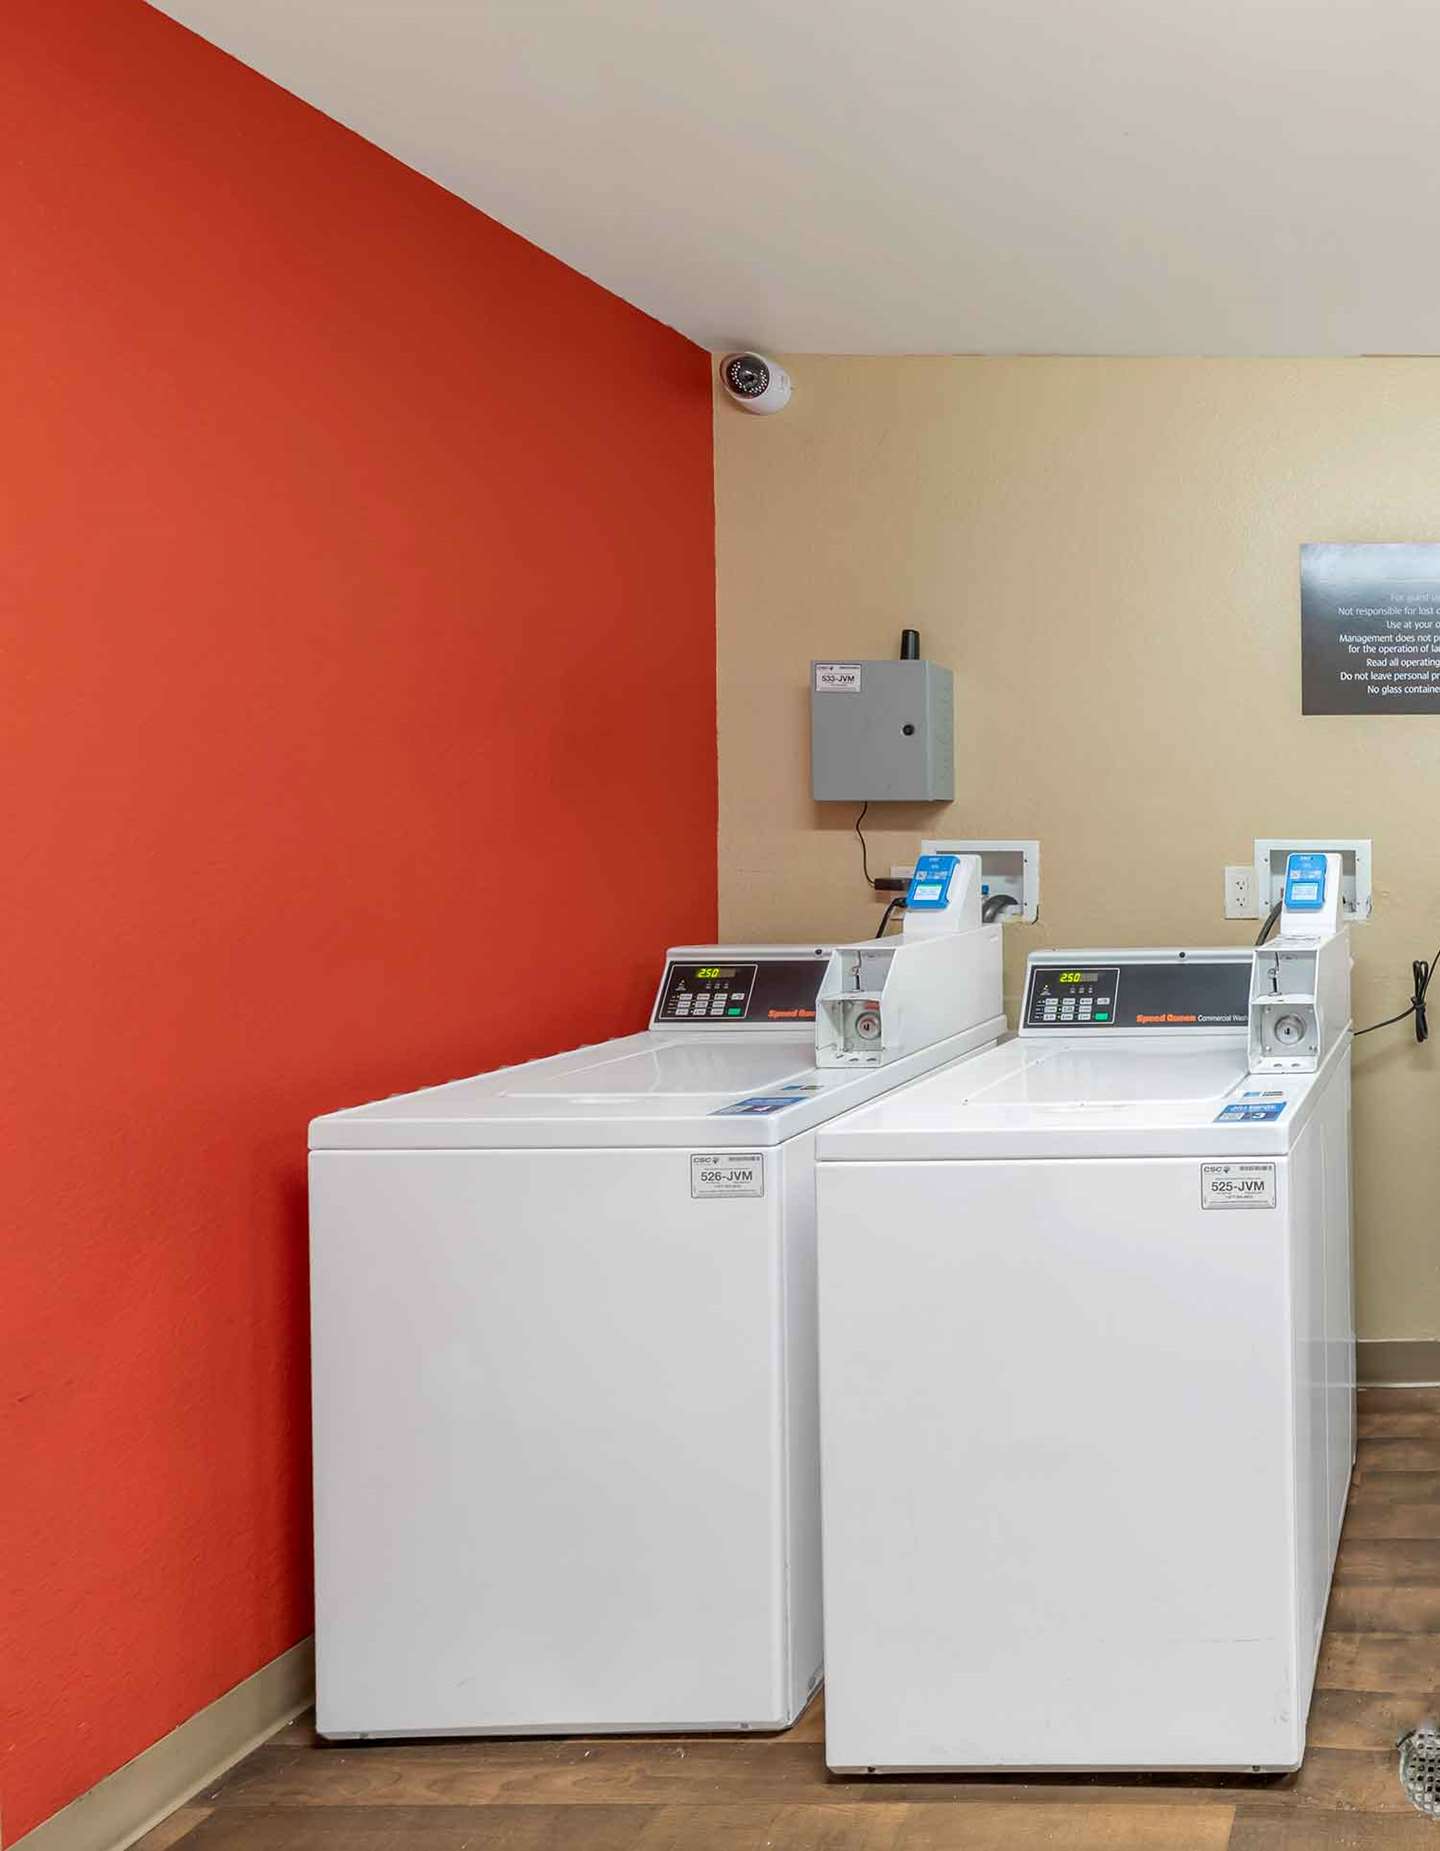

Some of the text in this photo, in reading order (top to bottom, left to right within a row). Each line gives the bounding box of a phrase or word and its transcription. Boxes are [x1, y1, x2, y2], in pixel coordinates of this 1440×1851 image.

[1338, 607, 1354, 615] Not
[1355, 607, 1401, 617] responsible
[1404, 607, 1416, 615] for
[1418, 607, 1434, 615] lost
[1386, 621, 1401, 629] Use
[1414, 622, 1433, 631] your
[1339, 634, 1394, 644] Management
[1395, 634, 1415, 642] does
[1417, 634, 1431, 642] not
[1348, 645, 1361, 653] for
[1363, 645, 1376, 653] the
[1378, 645, 1418, 655] operation
[1420, 645, 1429, 653] of
[1366, 658, 1387, 667] Read
[1389, 658, 1399, 667] all
[1400, 658, 1440, 669] operating
[1340, 672, 1353, 680] Do
[1354, 672, 1369, 680] not
[1370, 671, 1392, 680] leave
[1393, 671, 1430, 682] personal
[1367, 685, 1380, 693] No
[1382, 684, 1402, 695] glass
[1197, 1014, 1232, 1022] Commercial
[700, 1171, 753, 1182] 526-JVM
[1211, 1181, 1265, 1192] 525-JVM
